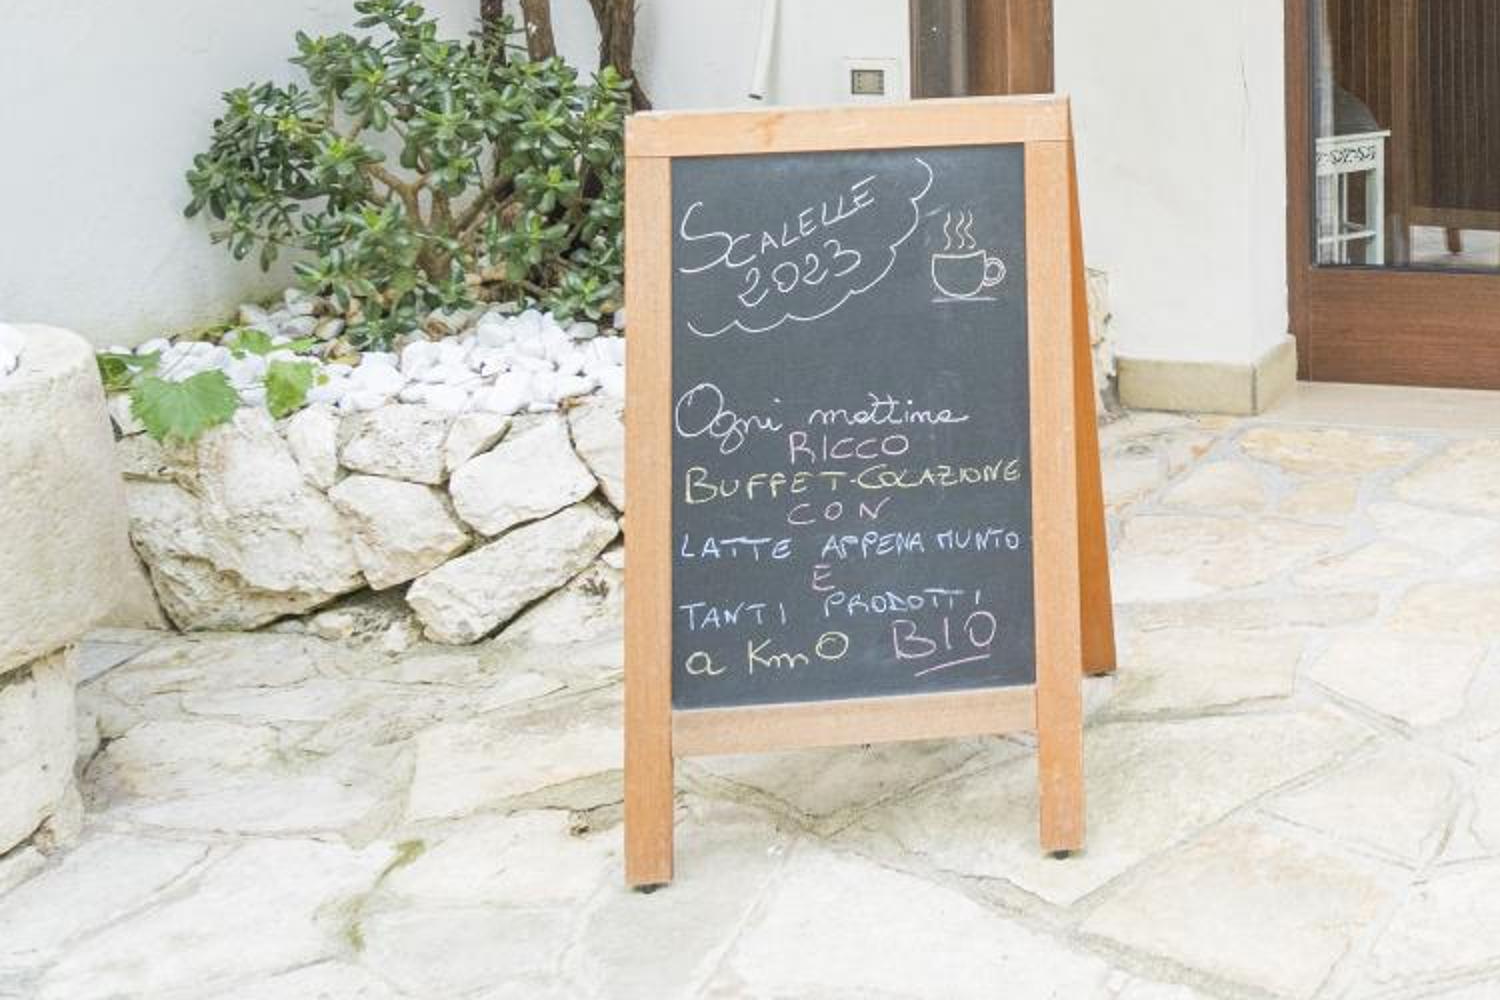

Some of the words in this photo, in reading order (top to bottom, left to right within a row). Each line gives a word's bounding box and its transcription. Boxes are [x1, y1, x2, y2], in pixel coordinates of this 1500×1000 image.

[737, 240, 861, 307] 2023
[675, 382, 783, 455] Ogni
[809, 391, 970, 426] mattina
[789, 431, 909, 464] RICCO
[786, 496, 892, 525] CON
[679, 537, 792, 561] LATTE
[821, 531, 925, 559] APPENA
[937, 528, 1021, 550] MUNTO
[812, 564, 836, 592] E
[679, 603, 788, 630] TANTI
[823, 588, 982, 617] PRODOTTI
[685, 651, 727, 676] a
[892, 610, 997, 660] BIO
